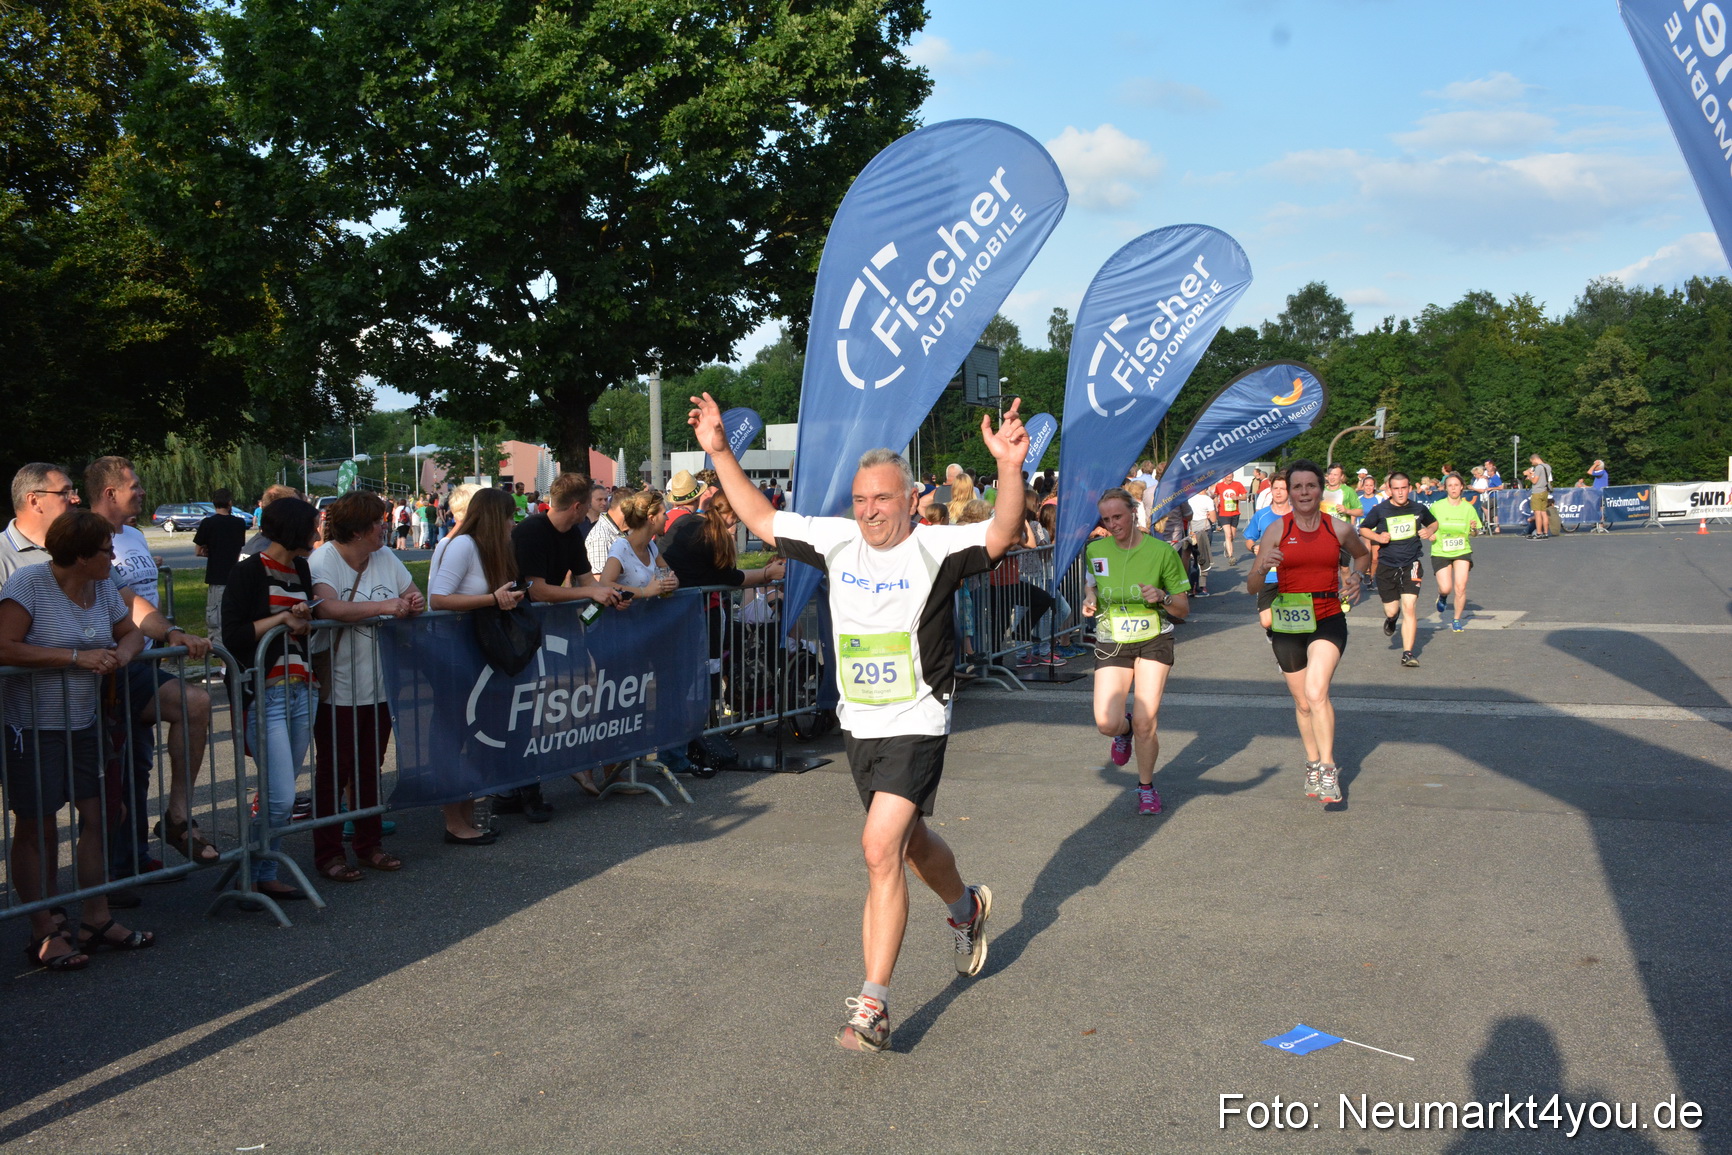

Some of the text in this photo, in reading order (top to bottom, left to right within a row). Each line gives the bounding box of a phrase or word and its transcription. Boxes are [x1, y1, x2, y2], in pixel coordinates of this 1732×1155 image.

[871, 166, 1011, 358] Fischer
[919, 203, 1028, 356] AUTOMOBILE
[1111, 254, 1210, 394] Fischer
[1146, 279, 1223, 391] AUTOMOBILE
[1028, 421, 1050, 456] Fischer
[1179, 407, 1283, 471] Frischmann
[1246, 400, 1318, 444] Druck und Medien
[1605, 497, 1640, 508] Frischmann
[1394, 524, 1411, 534] 702
[1444, 539, 1464, 547] 1598
[1121, 619, 1150, 632] 479
[1276, 609, 1311, 622] 1383
[852, 662, 897, 684] 295
[508, 668, 654, 732] Fischer
[523, 713, 644, 758] AUTOMOBILE
